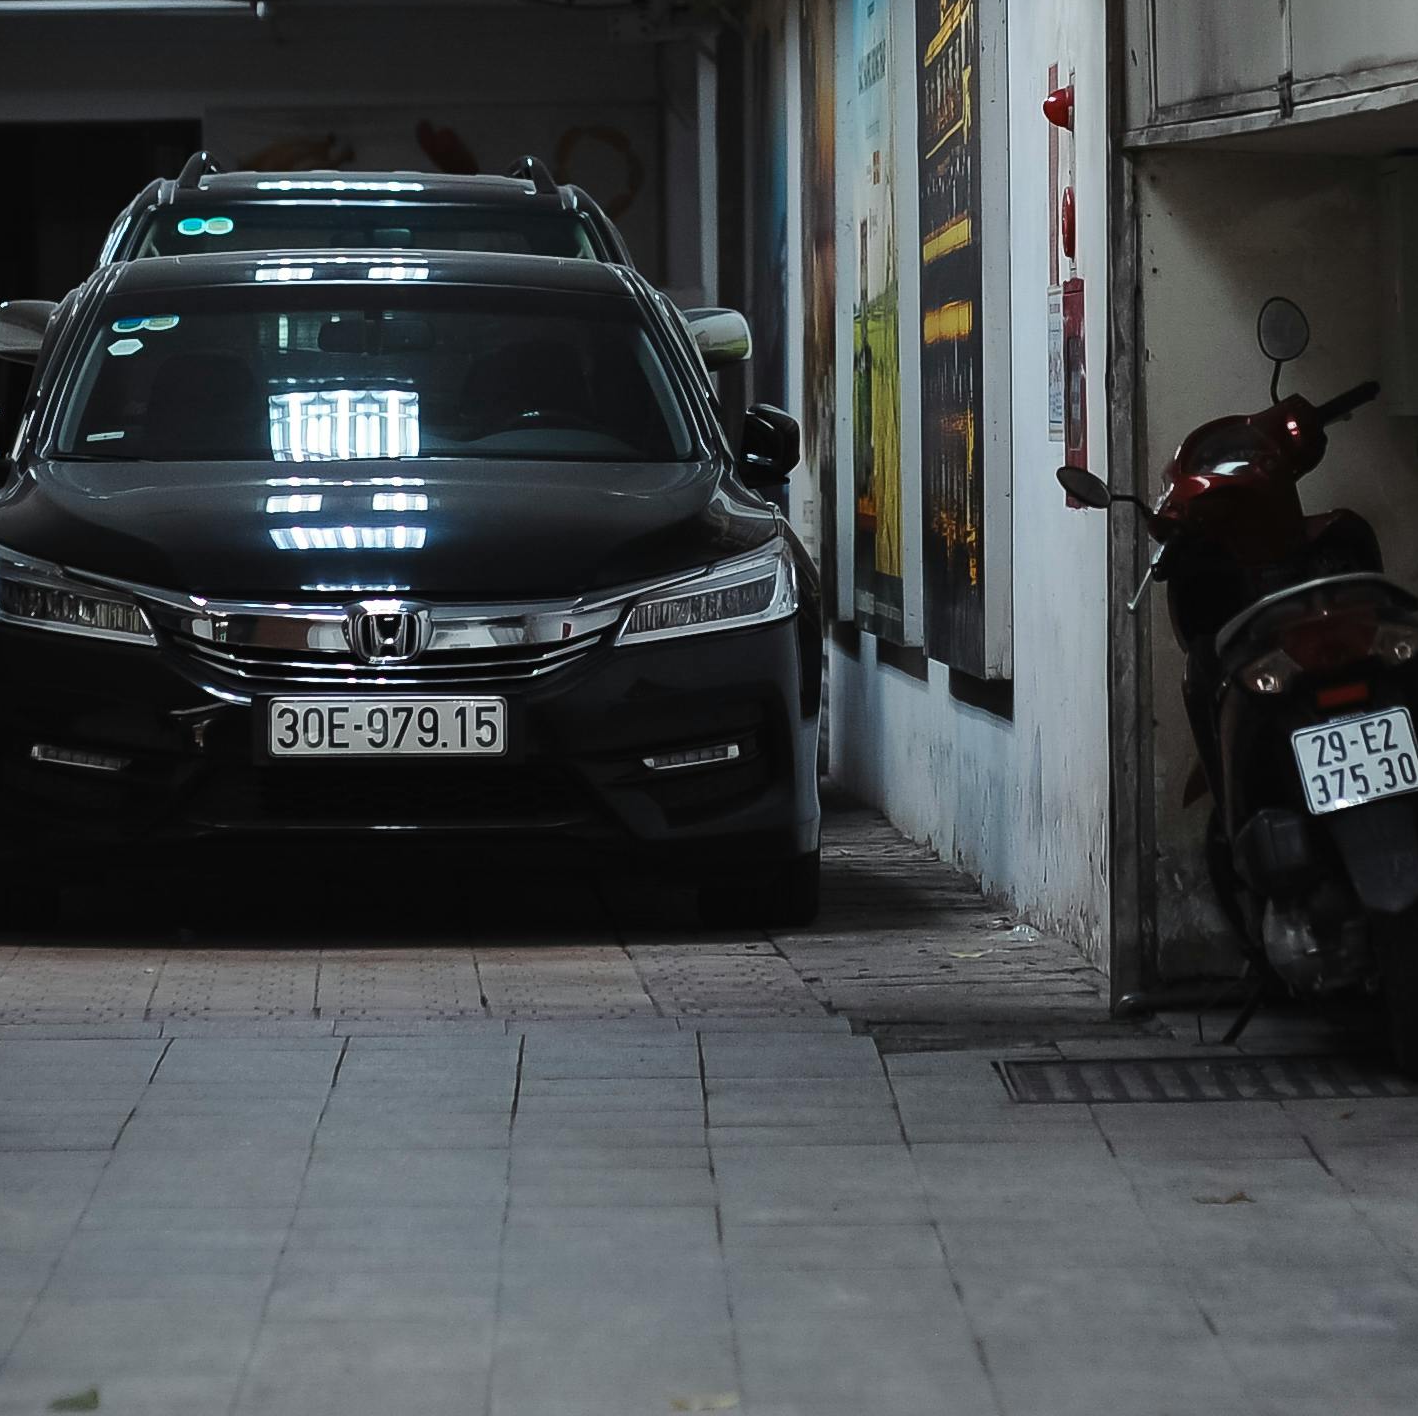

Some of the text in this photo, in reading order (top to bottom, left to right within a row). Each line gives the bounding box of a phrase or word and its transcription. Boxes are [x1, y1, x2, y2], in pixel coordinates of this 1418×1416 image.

[276, 706, 498, 749] 30E-979.15
[1311, 718, 1399, 768] 29-E2
[1311, 752, 1418, 806] 375.30
